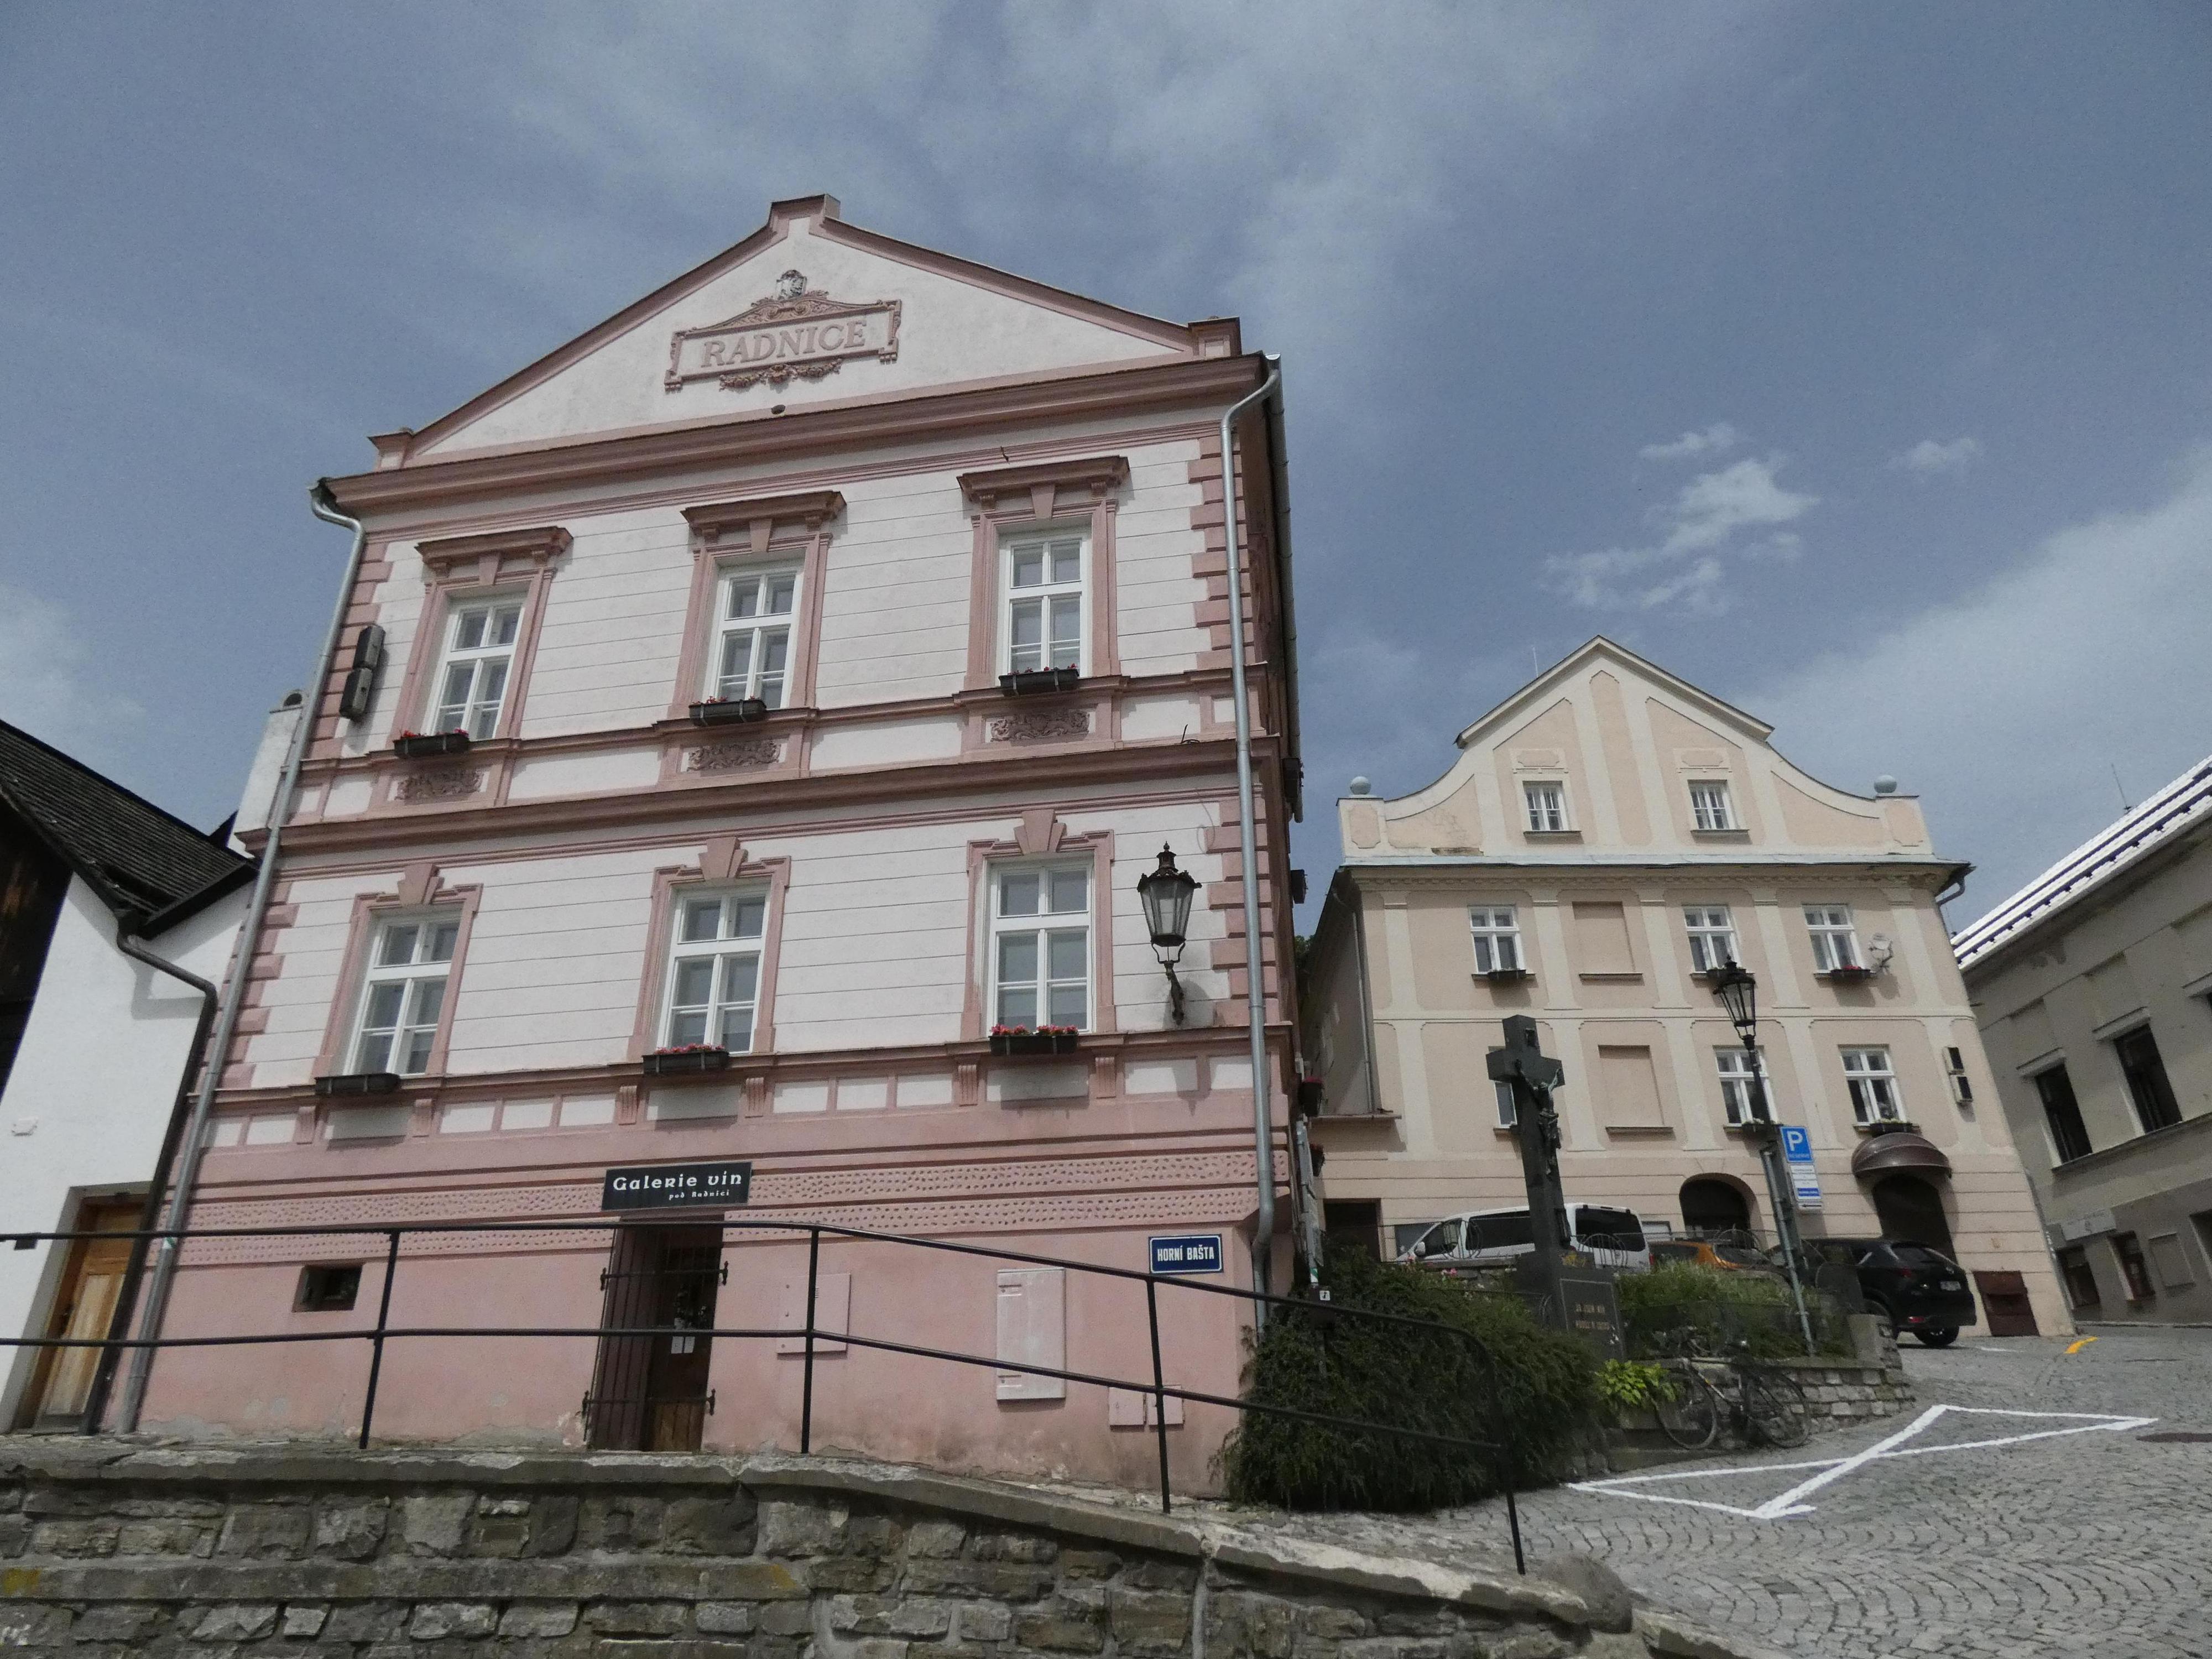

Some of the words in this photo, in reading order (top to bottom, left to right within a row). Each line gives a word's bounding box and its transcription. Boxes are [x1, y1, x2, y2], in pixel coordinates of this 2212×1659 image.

[701, 320, 867, 367] RADNICE
[1787, 1131, 1803, 1151] P
[613, 1173, 697, 1191] Galerie
[708, 1171, 742, 1186] vin
[1157, 1245, 1183, 1261] HORNÍ
[1187, 1244, 1214, 1260] BAŠTA
